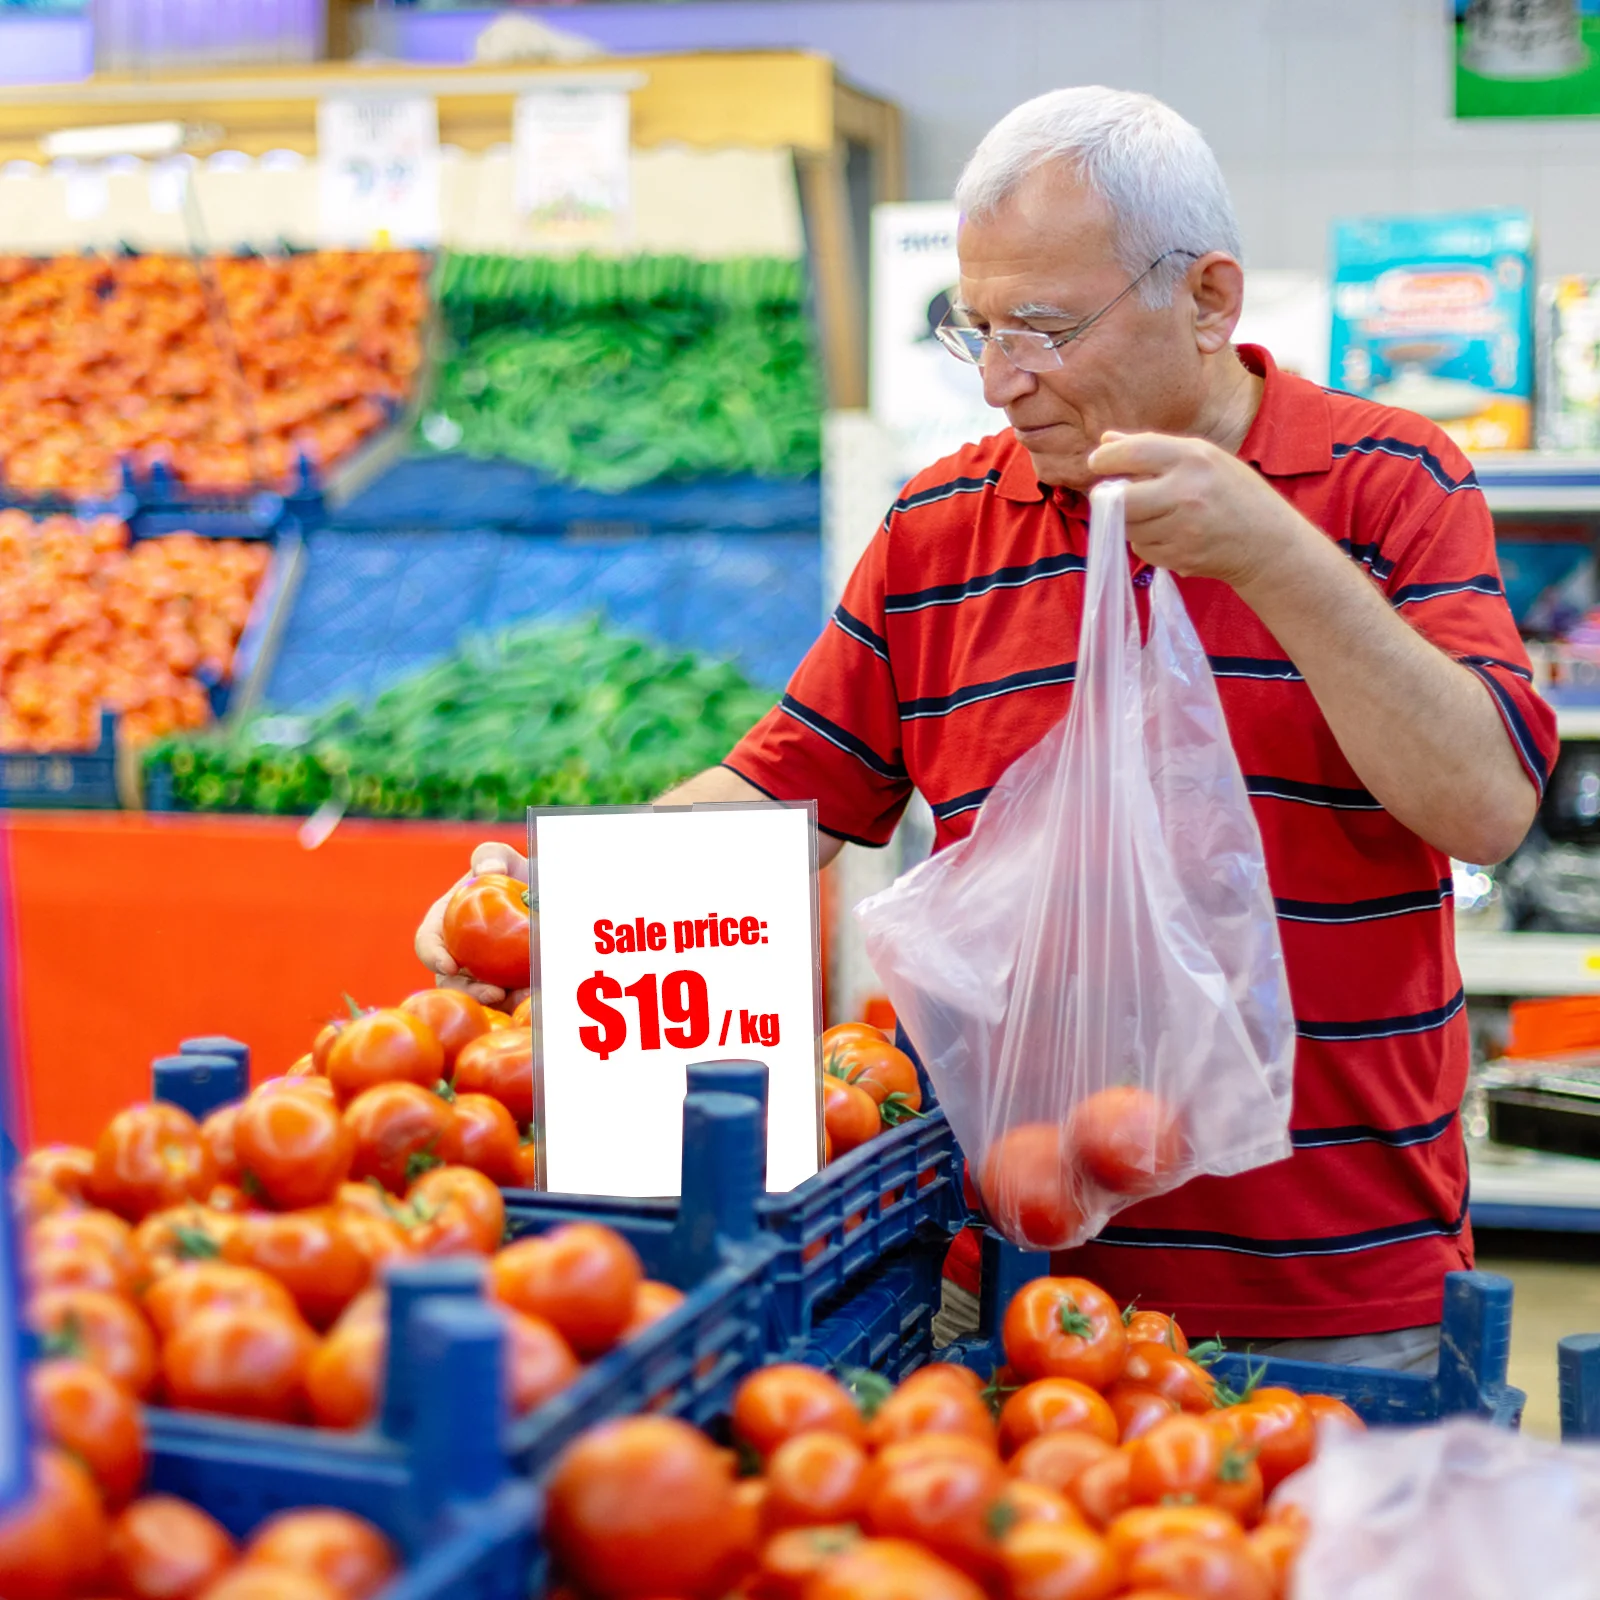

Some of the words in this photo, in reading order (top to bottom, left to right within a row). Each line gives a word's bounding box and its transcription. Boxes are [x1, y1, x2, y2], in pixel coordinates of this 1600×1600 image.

[593, 917, 667, 955] Sale
[673, 912, 769, 954] price:
[576, 969, 711, 1061] $19
[739, 1009, 781, 1048] kg
